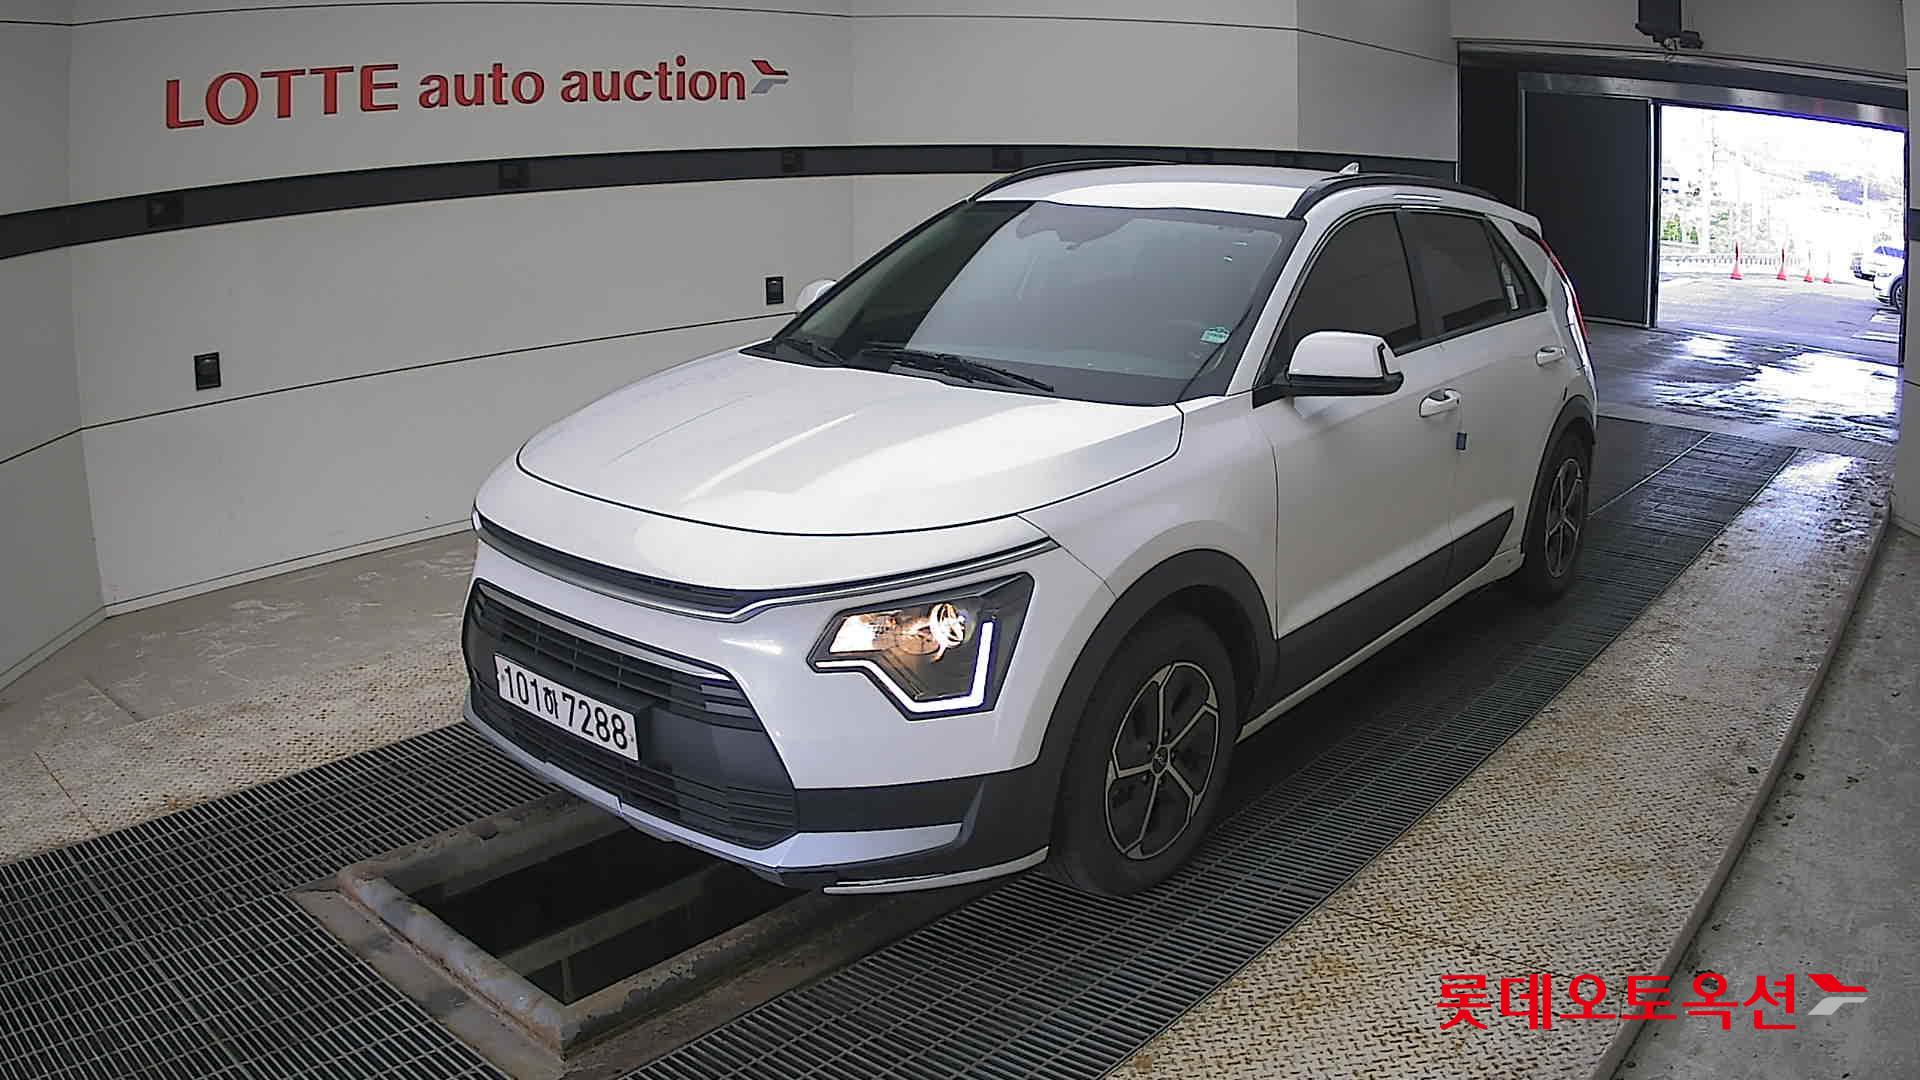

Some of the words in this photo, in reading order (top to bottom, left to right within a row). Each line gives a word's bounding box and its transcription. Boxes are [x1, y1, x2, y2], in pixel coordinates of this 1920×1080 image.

[165, 63, 399, 130] LOTTE
[418, 62, 545, 110] auto
[560, 55, 747, 103] auction
